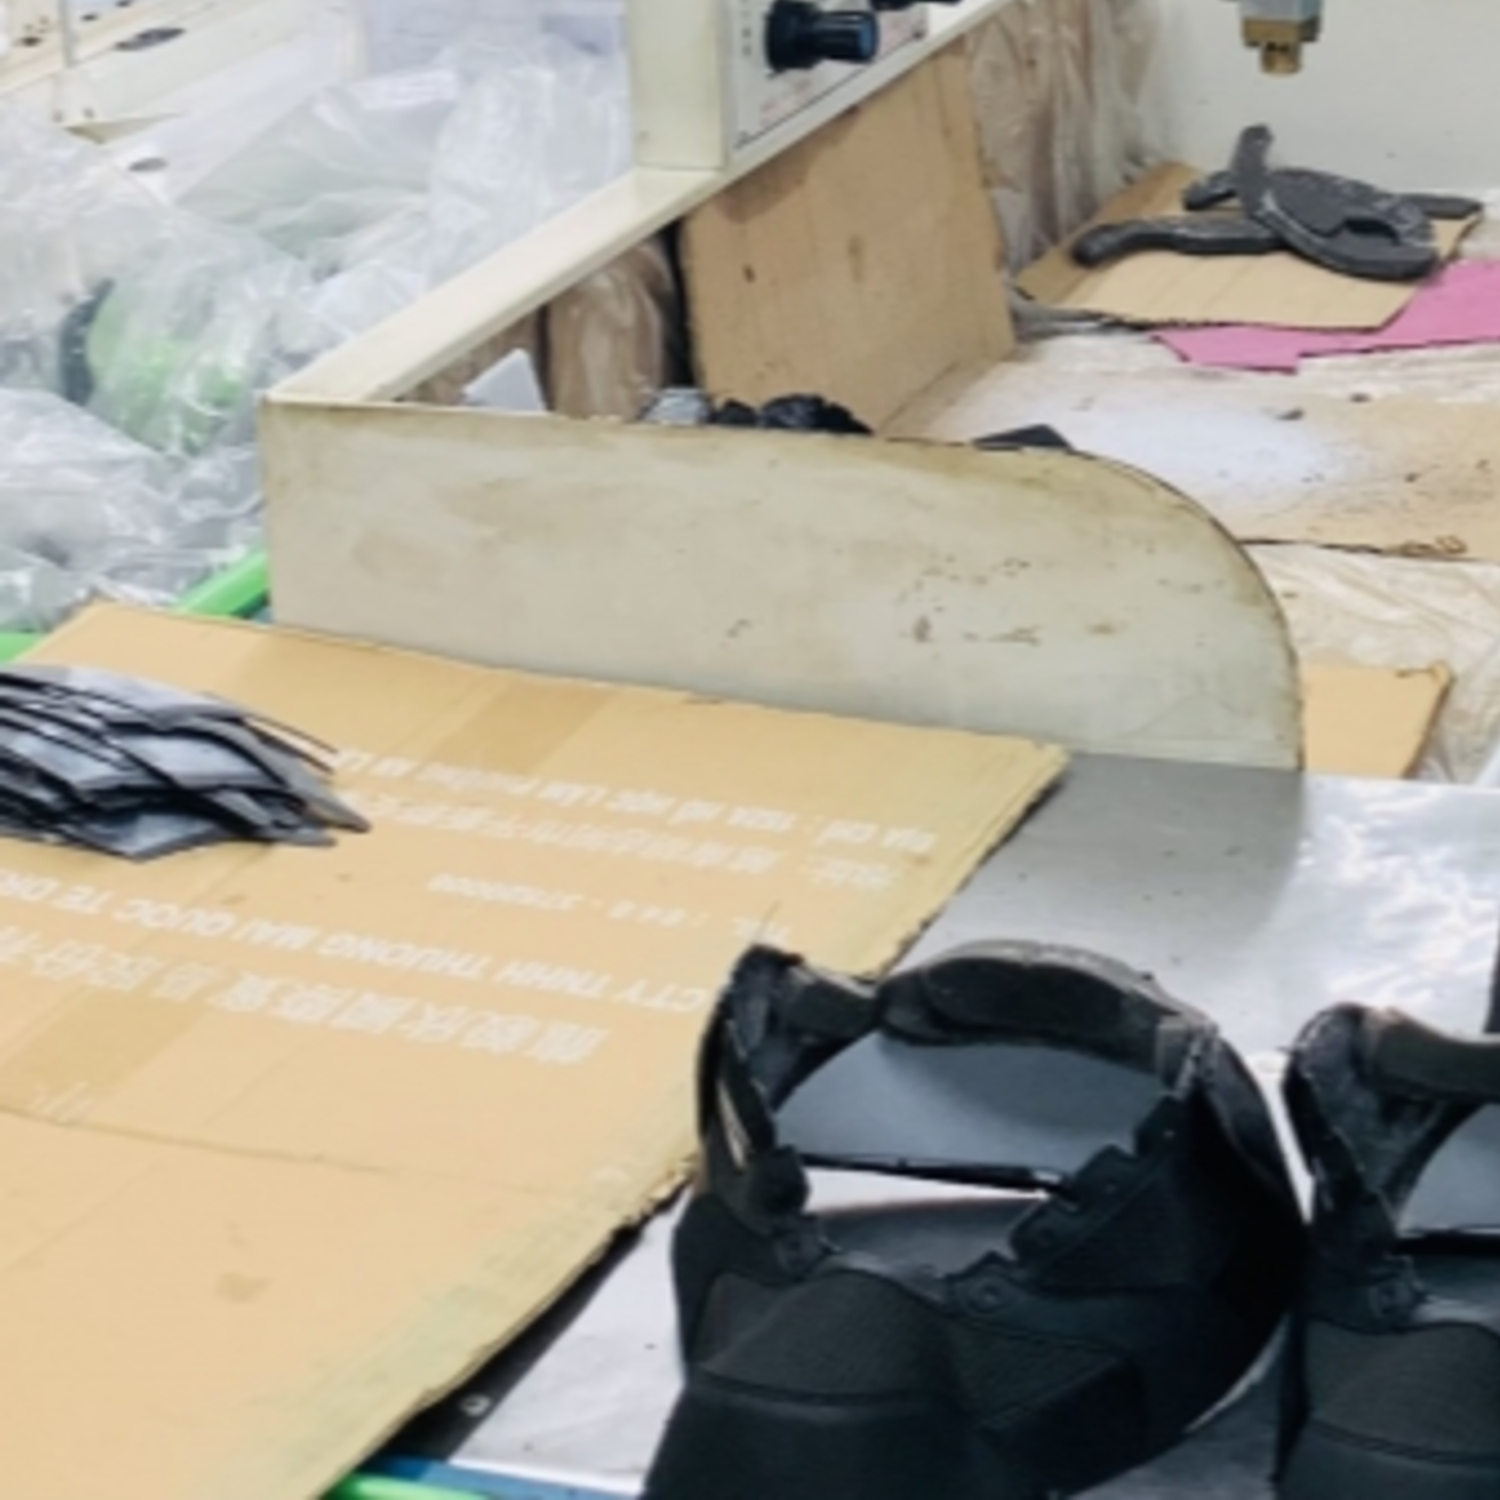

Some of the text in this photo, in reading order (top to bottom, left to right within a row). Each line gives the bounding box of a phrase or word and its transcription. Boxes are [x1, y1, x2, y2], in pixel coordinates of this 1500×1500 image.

[111, 897, 238, 937] QUOC
[316, 930, 493, 980] THUONG
[495, 959, 614, 998] TNHH
[612, 978, 715, 1013] CTY
